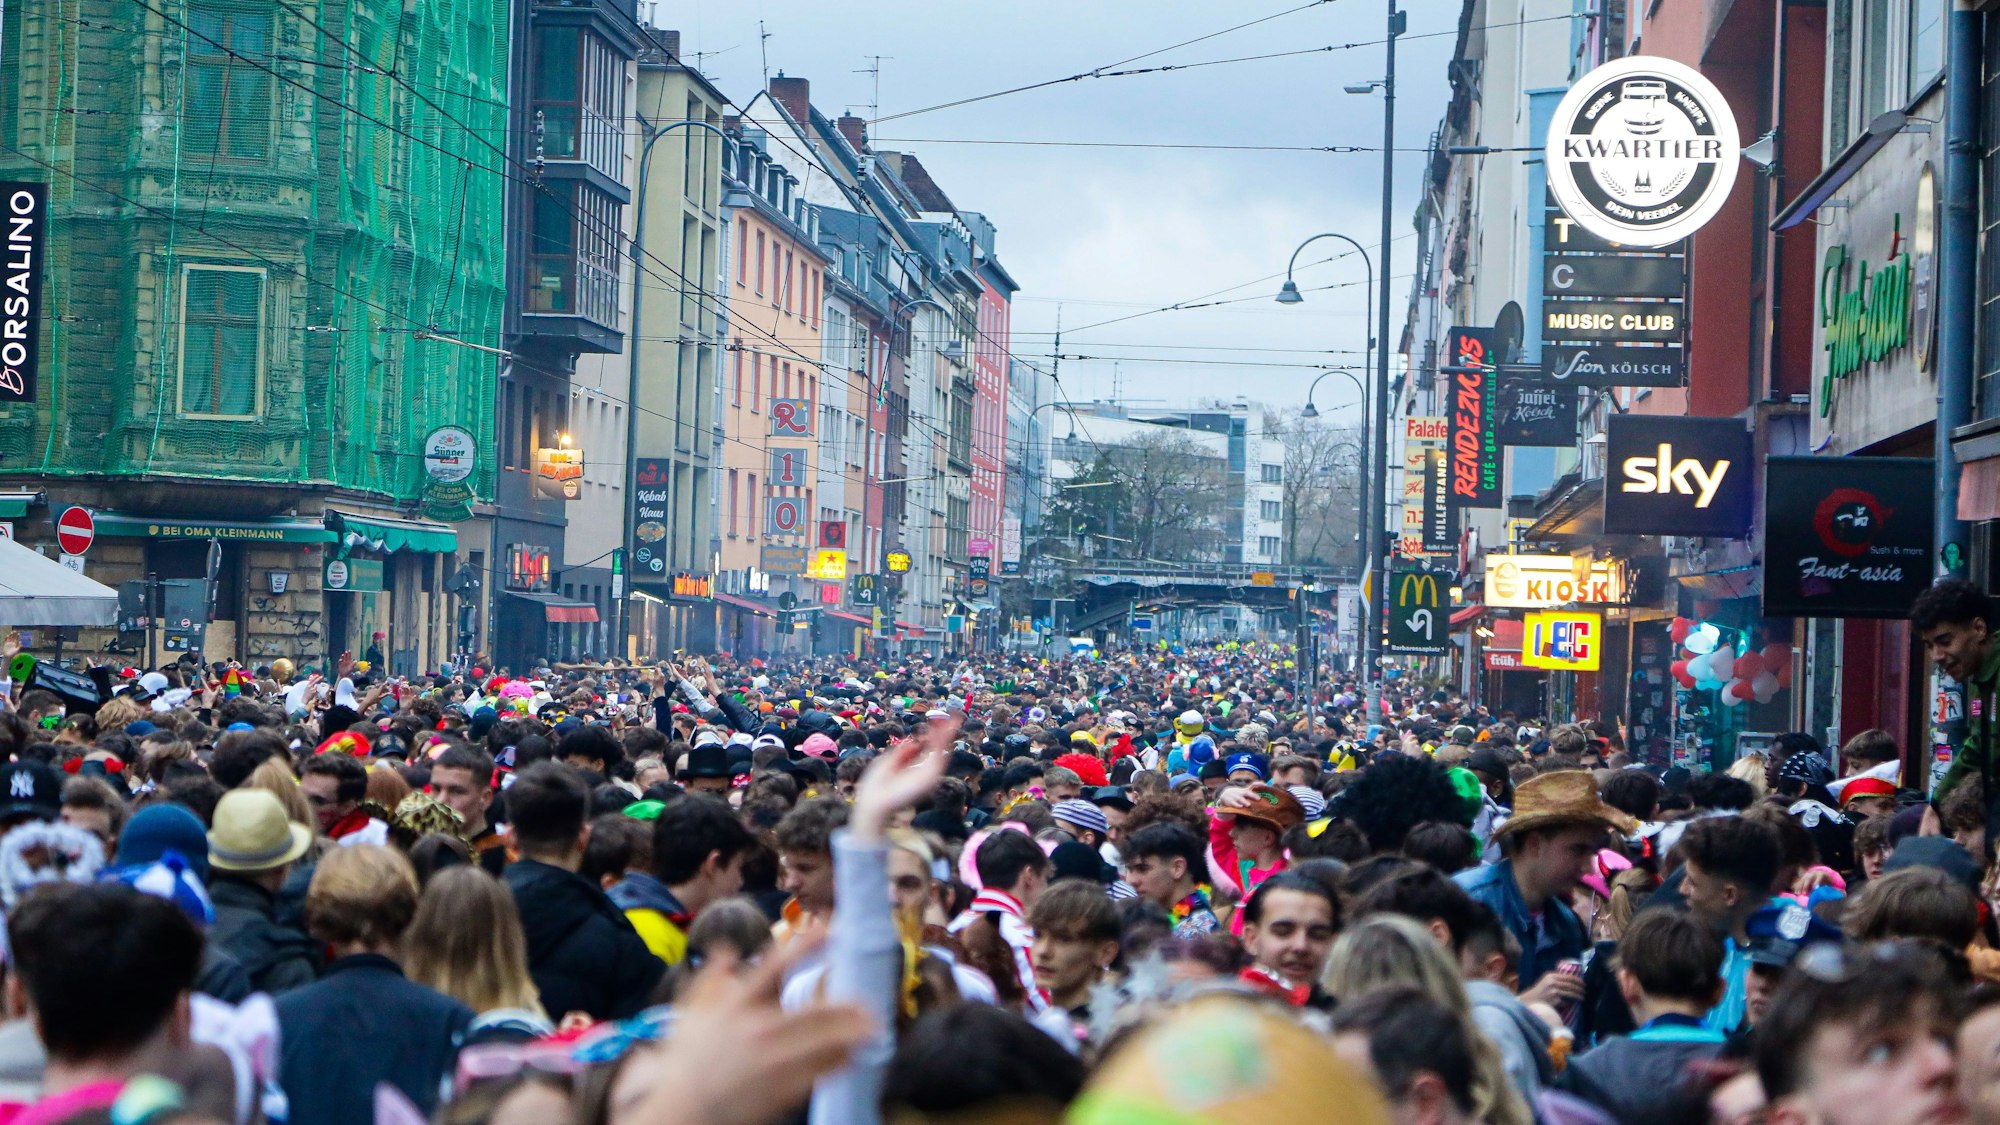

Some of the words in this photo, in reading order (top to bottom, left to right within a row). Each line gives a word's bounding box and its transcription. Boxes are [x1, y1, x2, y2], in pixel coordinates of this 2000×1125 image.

[1584, 91, 1616, 120] DEINE
[1674, 91, 1708, 126] KNEIPE
[1564, 138, 1723, 159] KWARTIER
[1605, 201, 1636, 220] DEIN
[1636, 202, 1684, 221] VEEDEL
[0, 190, 36, 395] BORSALINO
[1549, 314, 1614, 330] MUSIC
[1620, 315, 1675, 331] CLUB
[1551, 350, 1607, 380] Sion
[1611, 361, 1672, 375] KÖLSCH
[1407, 419, 1448, 438] Falafe
[1483, 462, 1497, 490] CAFÉ
[1622, 442, 1731, 509] sky
[638, 490, 667, 504] Kebab
[639, 507, 664, 518] Haus
[162, 526, 181, 536] BEI
[184, 527, 212, 537] OMA
[215, 527, 284, 539] KLEINMANN
[886, 553, 911, 563] SOUL
[889, 562, 908, 571] BAR
[1798, 556, 1904, 583] Fant-asia
[1527, 580, 1609, 602] KIOSK
